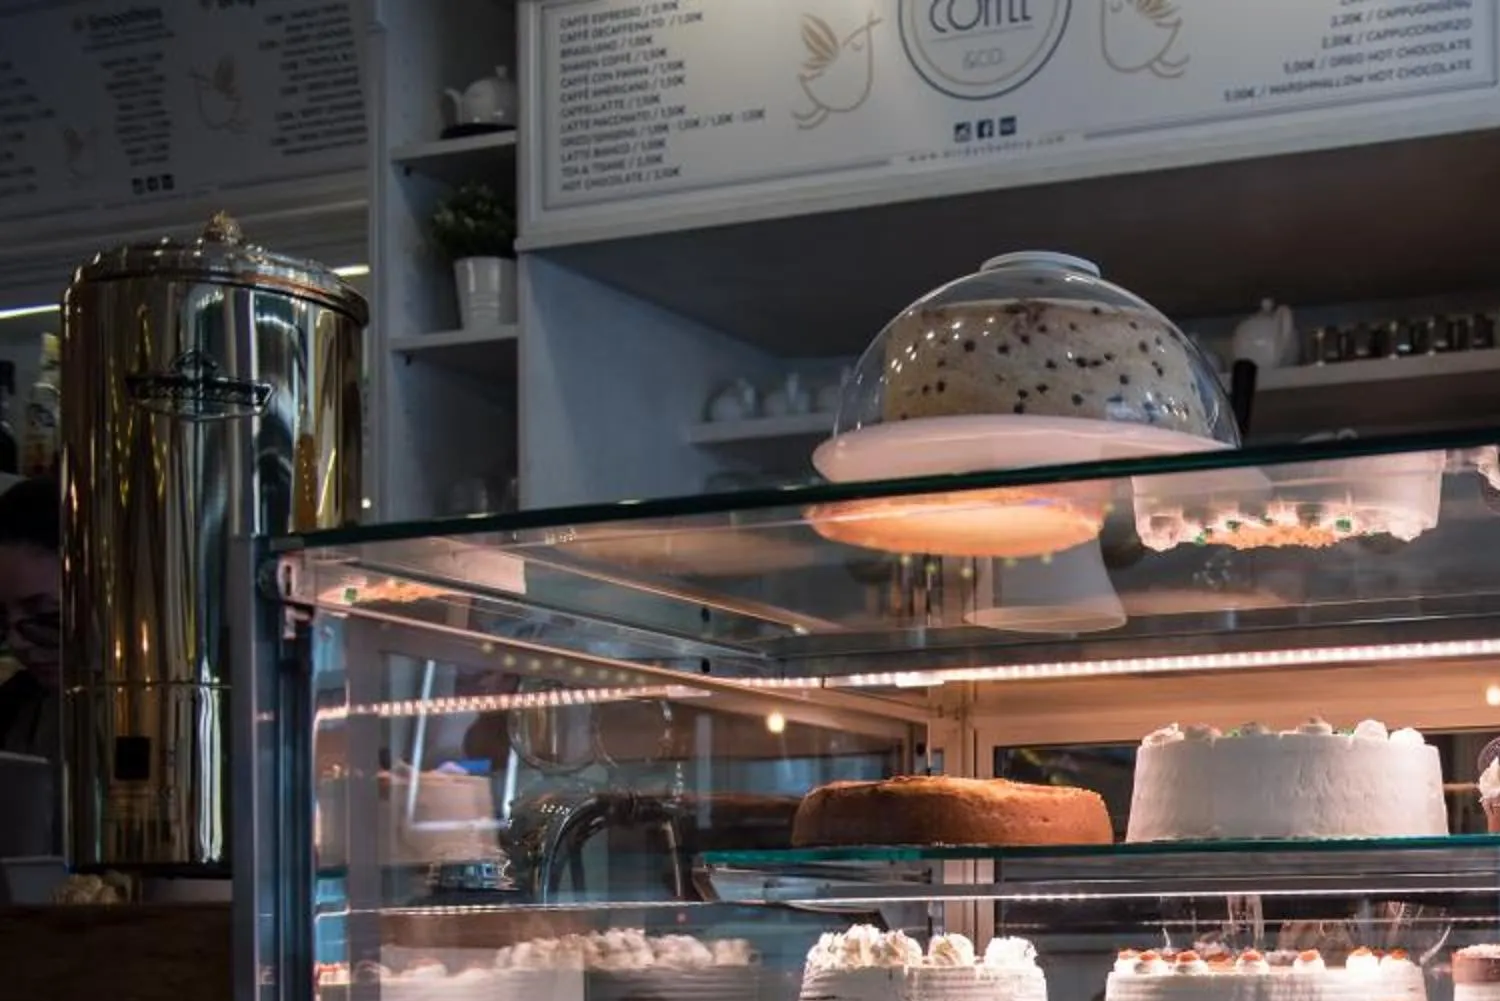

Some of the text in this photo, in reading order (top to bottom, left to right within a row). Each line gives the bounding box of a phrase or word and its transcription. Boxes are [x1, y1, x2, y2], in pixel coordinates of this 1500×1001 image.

[1367, 48, 1393, 62] HOT
[1396, 38, 1471, 59] CHOCOLATE
[1367, 69, 1393, 82] HOT
[1396, 59, 1471, 80] CHOCOLATE
[560, 119, 589, 135] LATTE
[584, 171, 642, 191] CHOCOLATE
